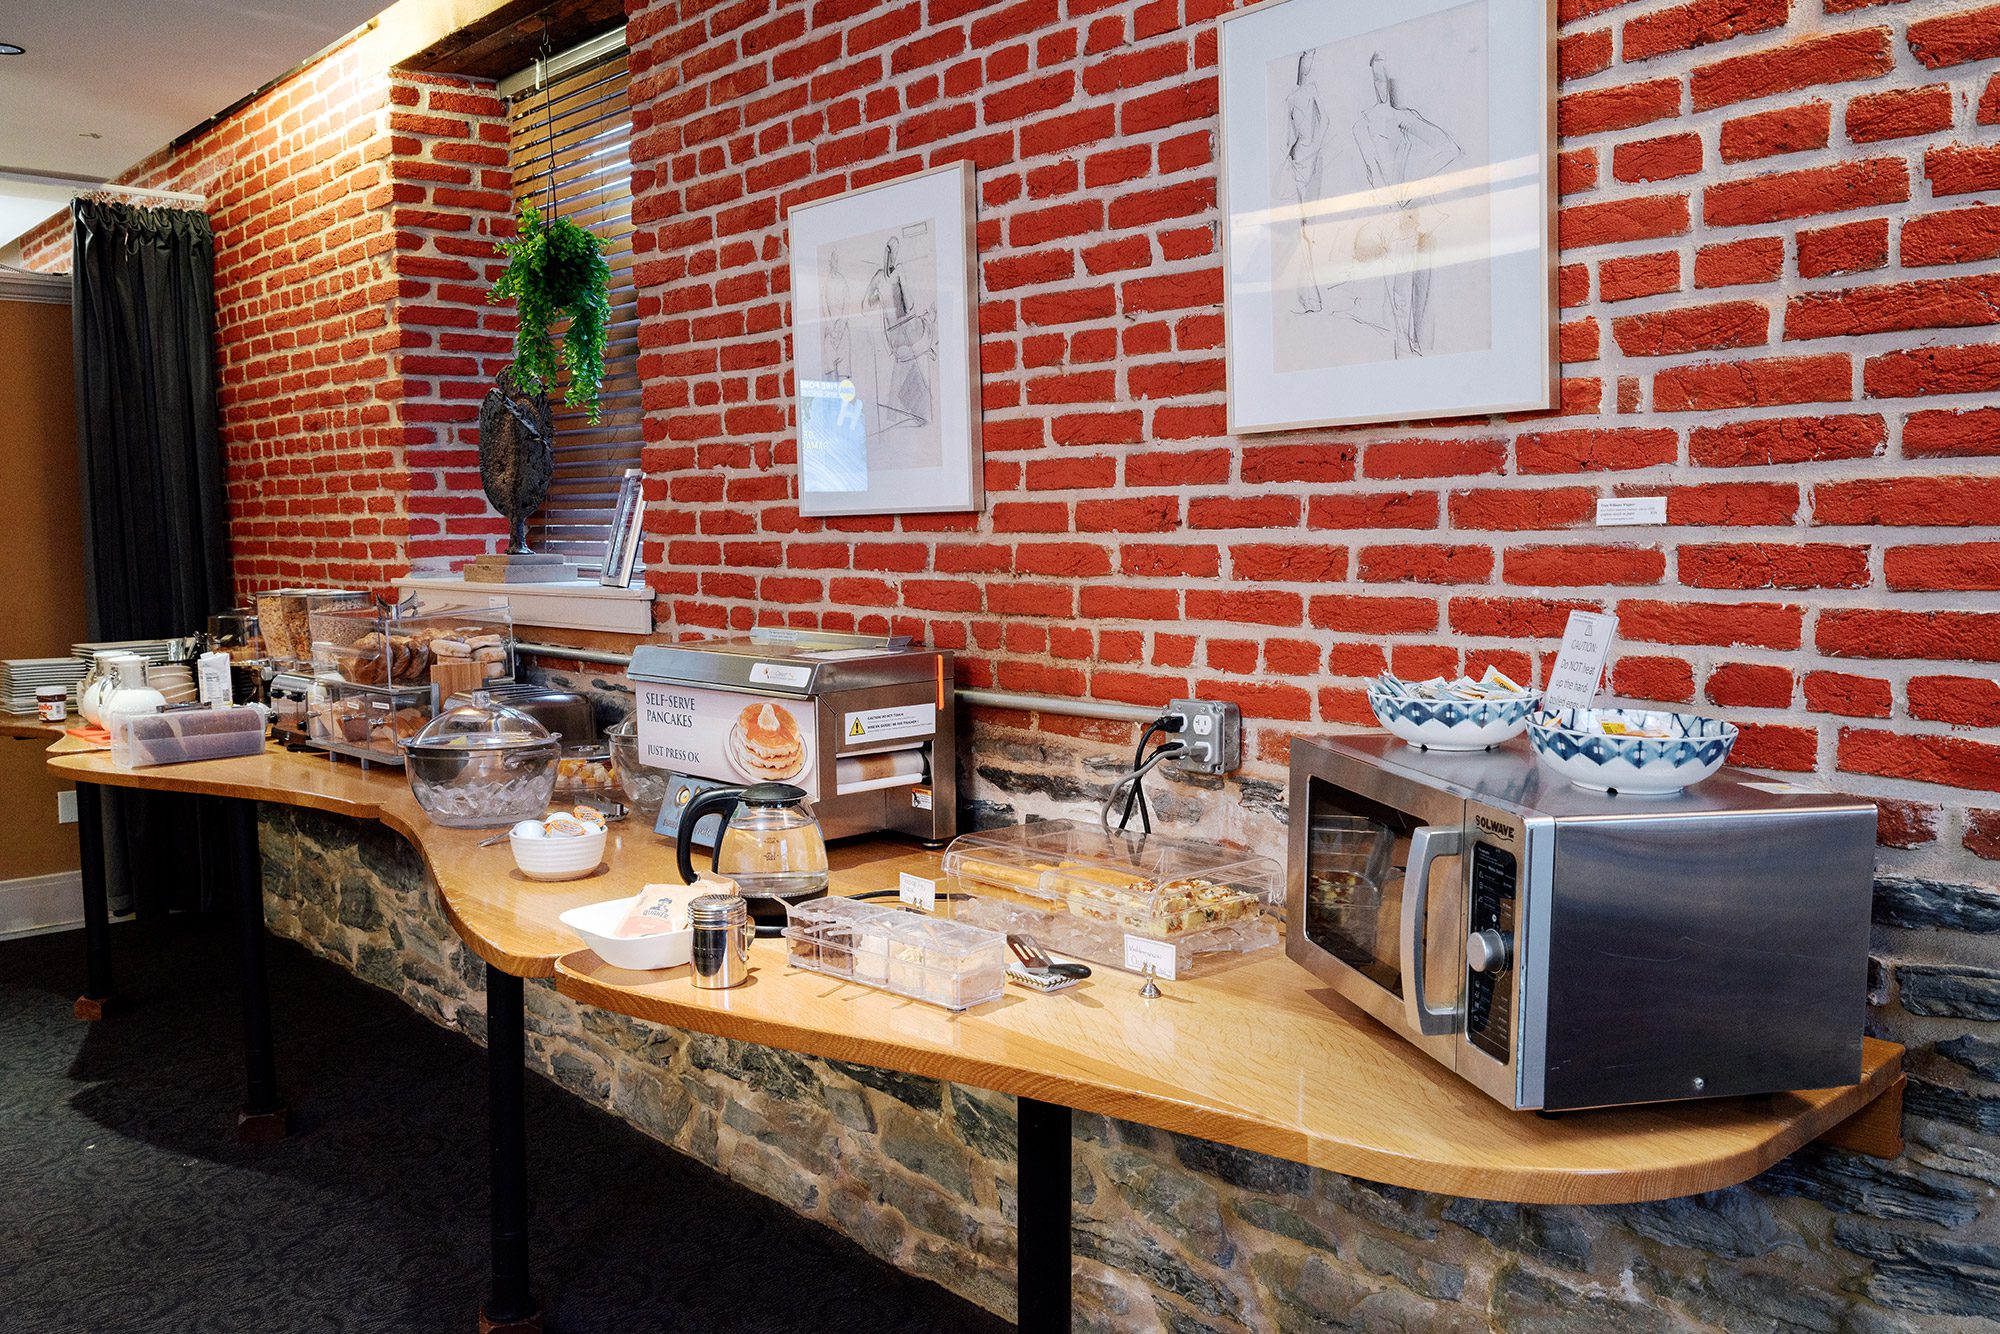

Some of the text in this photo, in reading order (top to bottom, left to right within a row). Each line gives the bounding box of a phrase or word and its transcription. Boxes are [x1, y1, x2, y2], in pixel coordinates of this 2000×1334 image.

[1560, 658, 1596, 675] Do NOT heat
[1563, 680, 1574, 690] the
[646, 692, 695, 711] SELF-SERVE
[646, 709, 693, 728] PANCAKES
[648, 744, 700, 763] JUST PRESS OK
[1475, 814, 1514, 838] SOLWAVE
